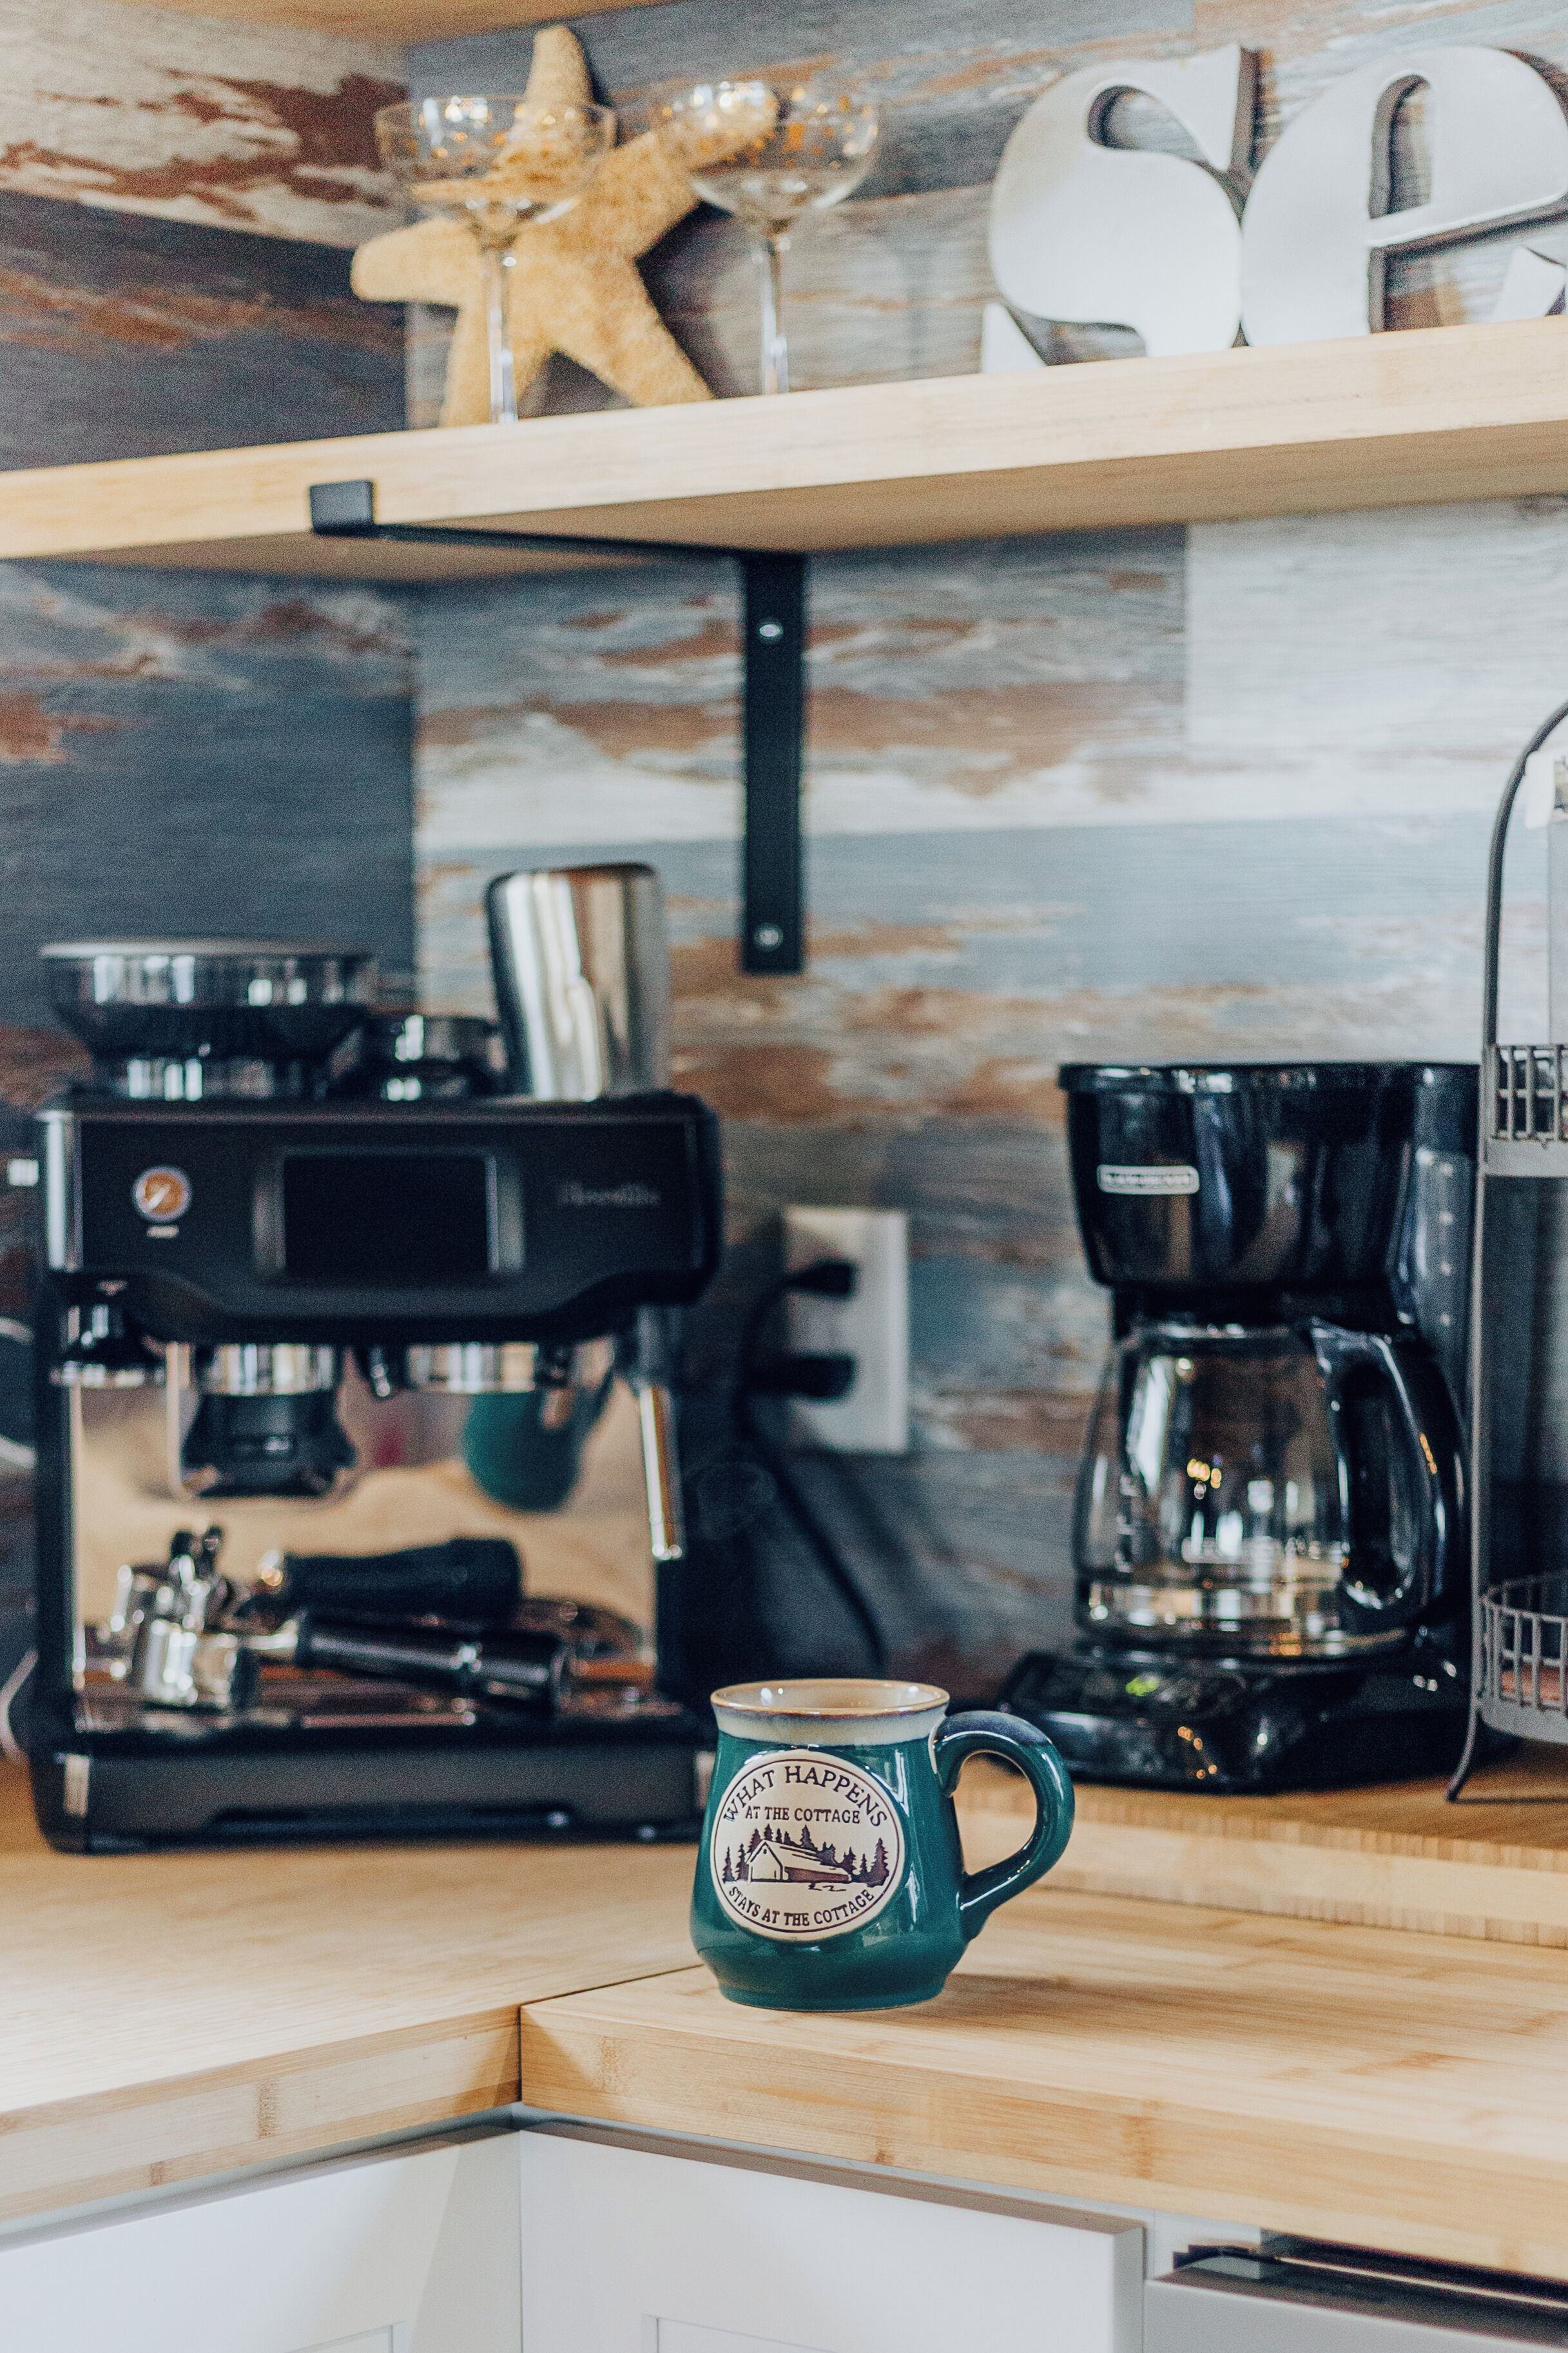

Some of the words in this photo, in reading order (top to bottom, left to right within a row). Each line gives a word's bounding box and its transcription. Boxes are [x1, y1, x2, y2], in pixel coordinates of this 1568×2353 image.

[980, 44, 1568, 374] se
[723, 1769, 775, 1821] WHAT
[784, 1765, 887, 1827] HAPPENS
[745, 1805, 760, 1819] AT
[764, 1806, 789, 1821] THE
[794, 1808, 860, 1824] COTTAGE
[729, 1886, 760, 1917] STAYS
[761, 1908, 780, 1924] AT
[784, 1912, 810, 1926] THE
[813, 1889, 875, 1924] COTTAGE
